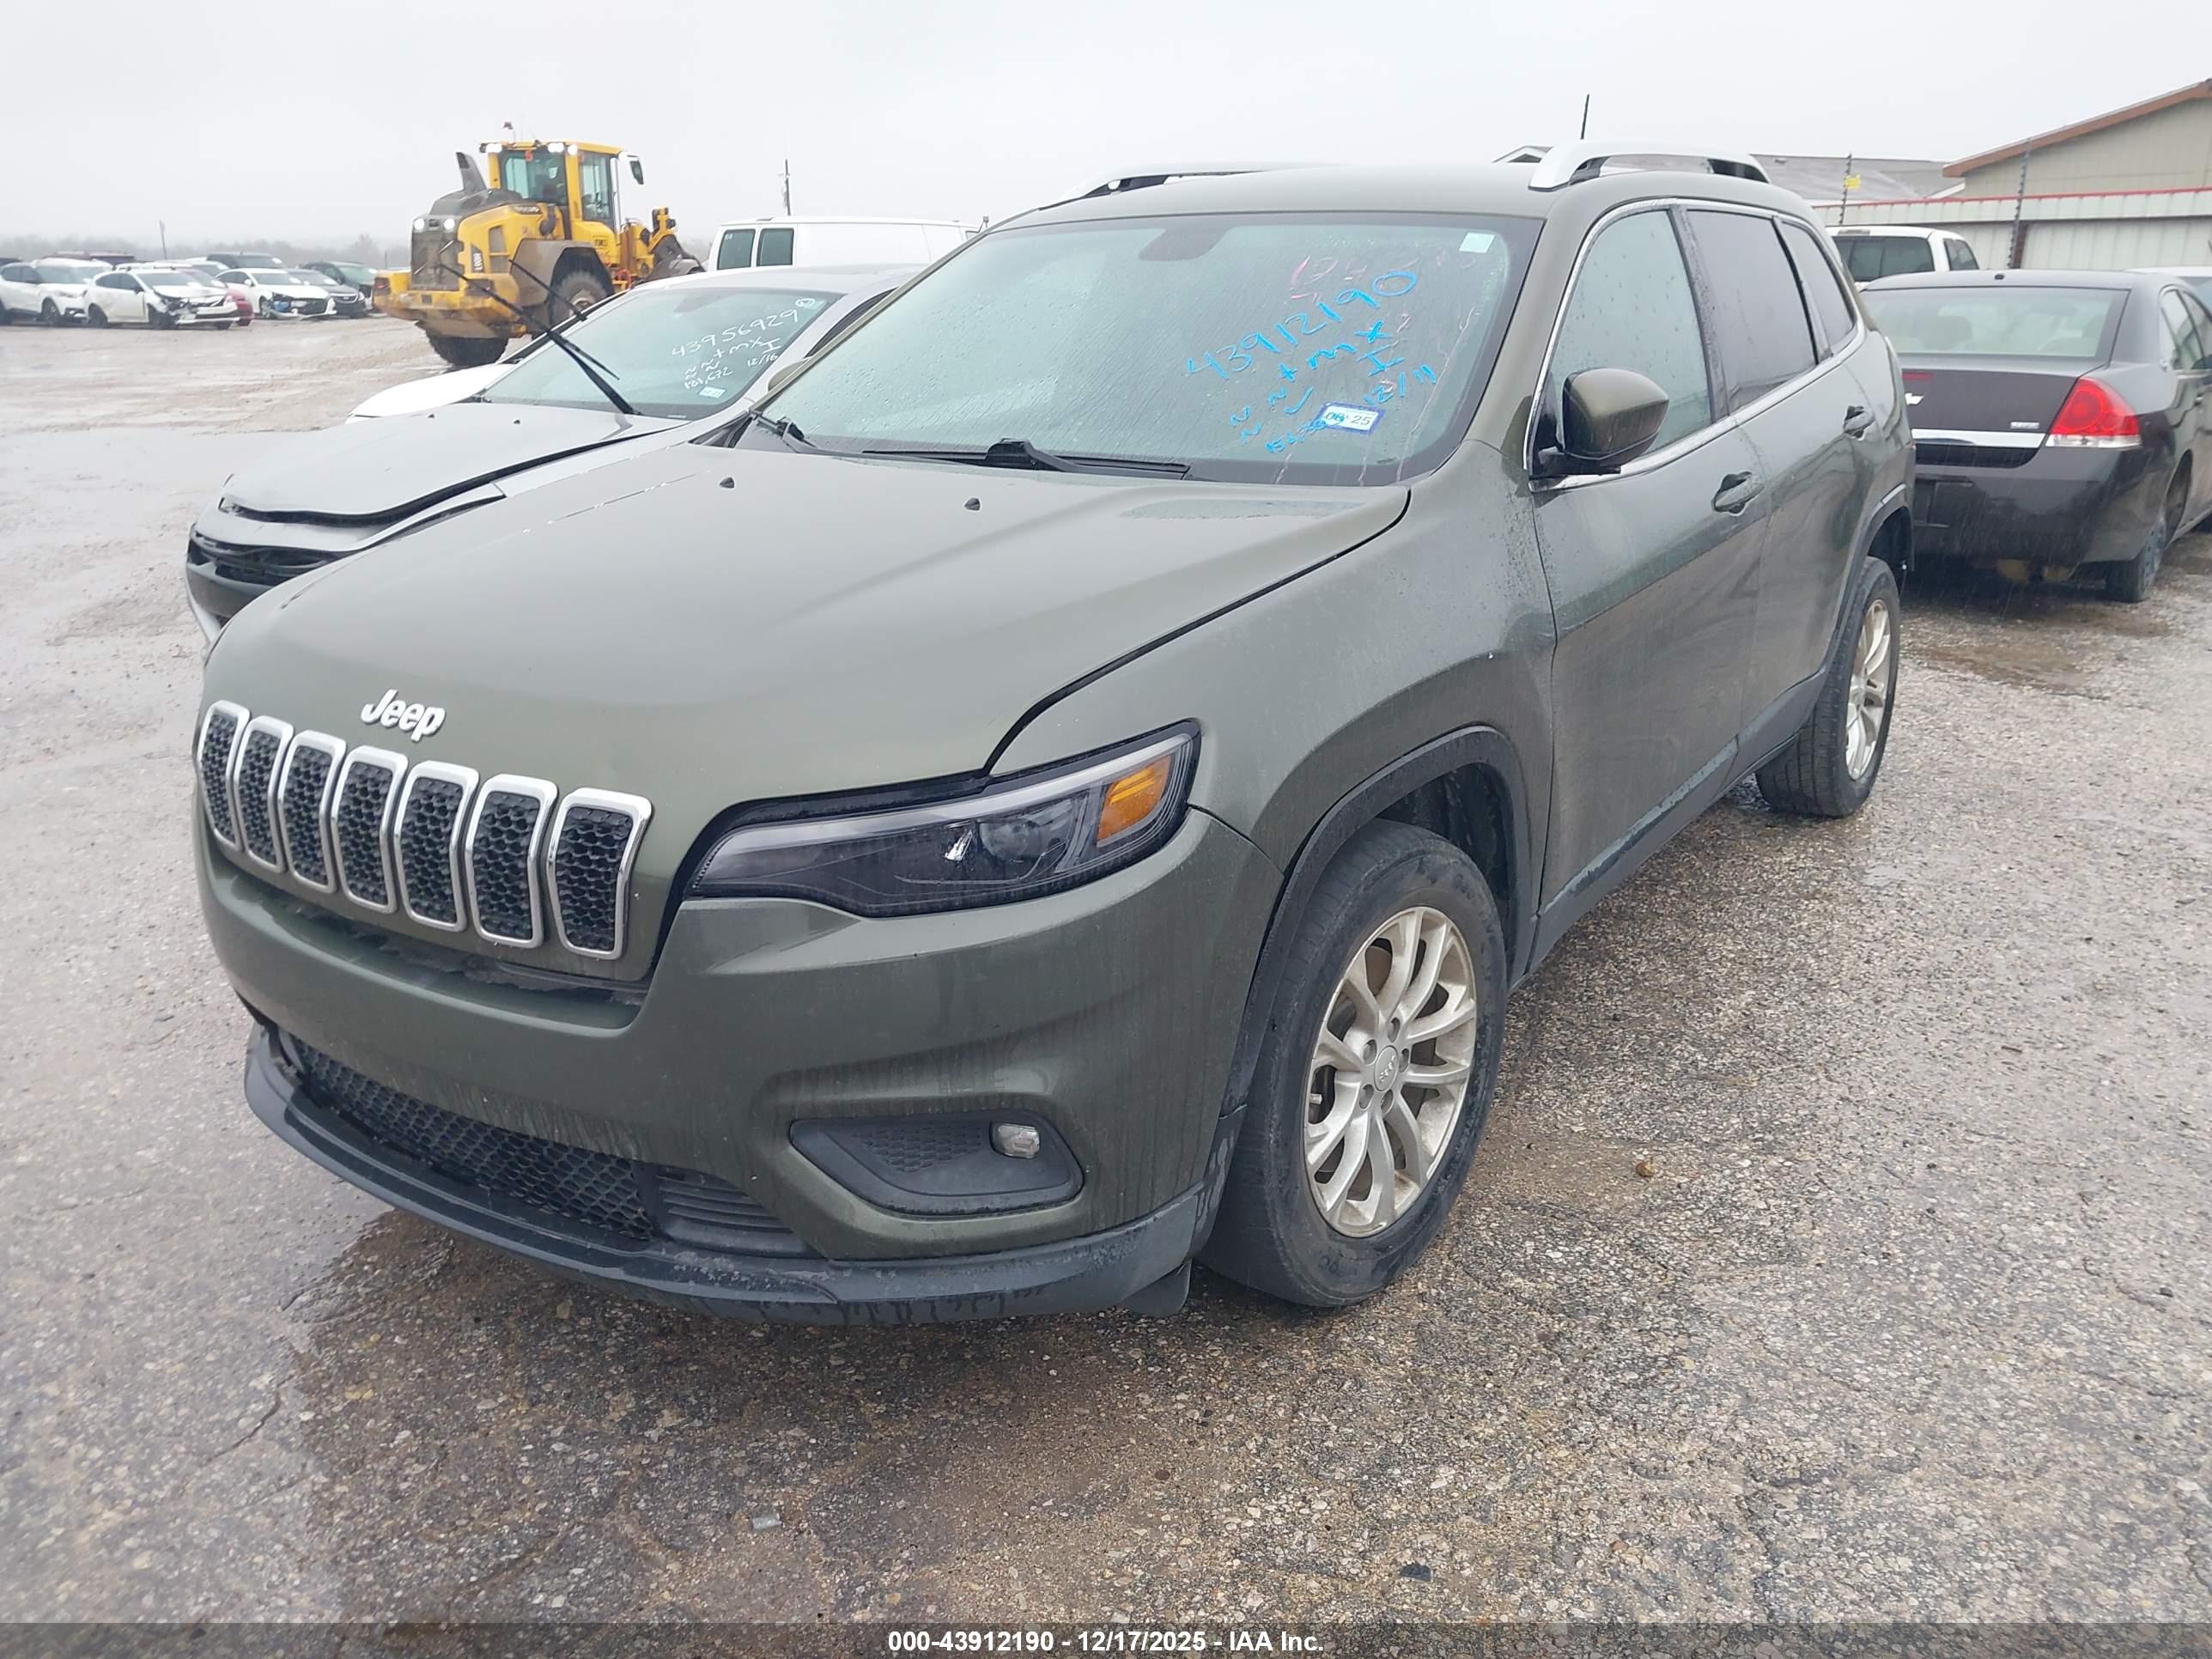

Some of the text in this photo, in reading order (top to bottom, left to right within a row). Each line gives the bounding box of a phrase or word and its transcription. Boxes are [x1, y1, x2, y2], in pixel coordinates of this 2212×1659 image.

[672, 309, 798, 356] 43956929
[1186, 270, 1417, 380] 43912190
[1350, 415, 1372, 426] 25
[361, 687, 446, 743] Jeep
